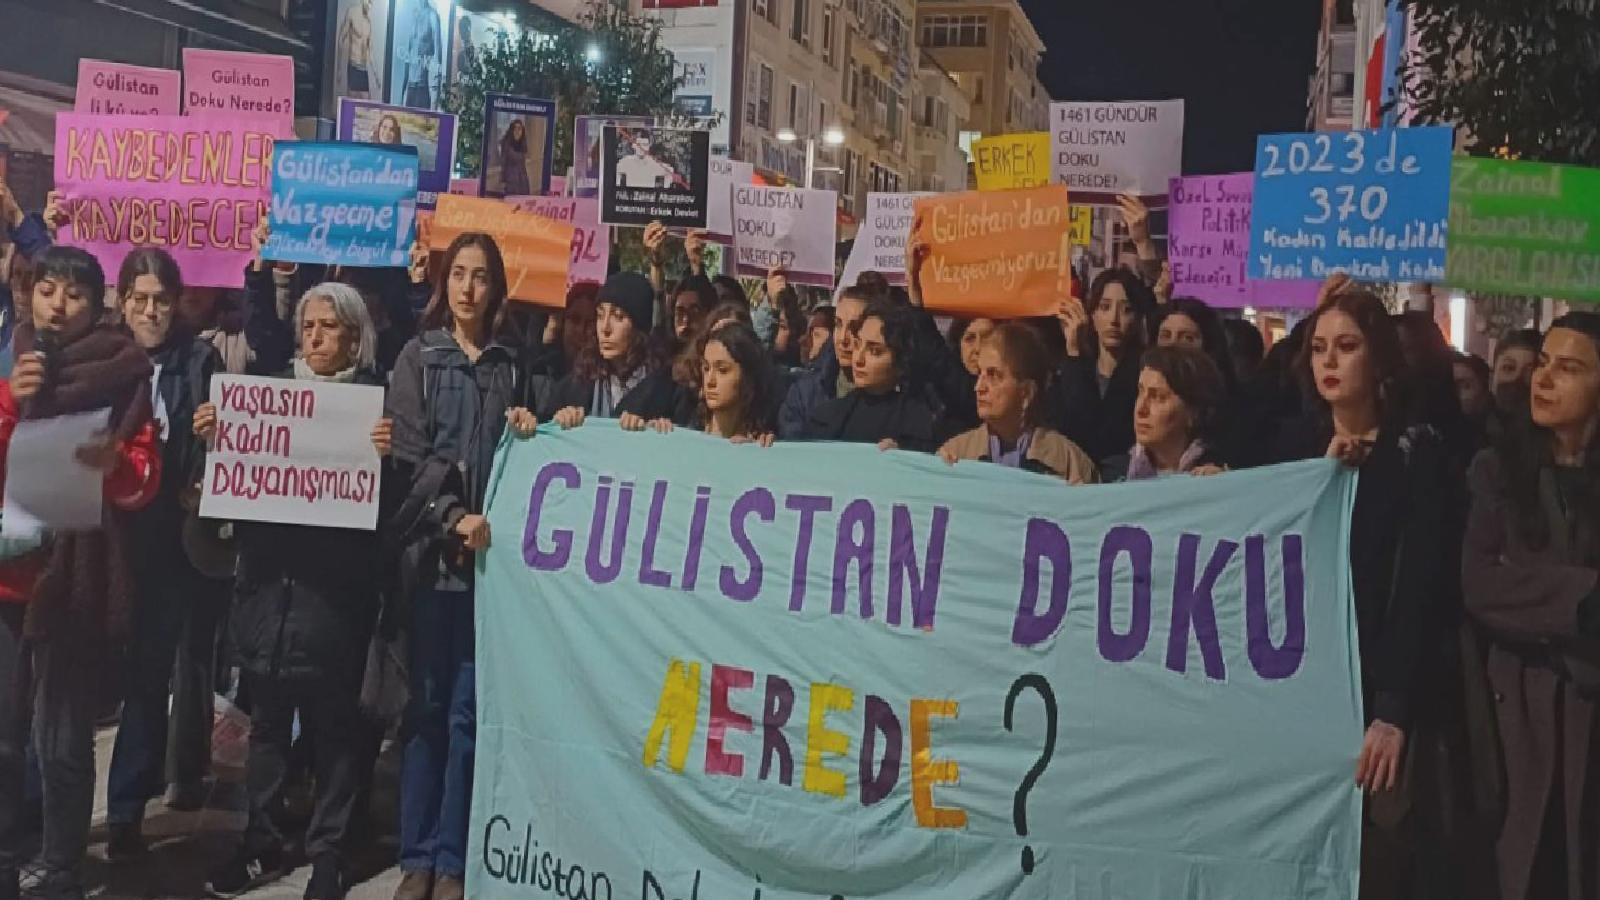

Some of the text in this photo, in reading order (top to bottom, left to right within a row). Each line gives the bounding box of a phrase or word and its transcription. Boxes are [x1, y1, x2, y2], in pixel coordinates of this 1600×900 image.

[93, 71, 159, 96] Gülistan
[211, 69, 270, 88] Gülistan
[189, 91, 292, 114] Doku Nerede?
[1059, 103, 1158, 123] 1461 GÜNDÜR
[1058, 128, 1126, 145] GÜLİSTAN
[978, 142, 1036, 176] ERKEK
[1058, 151, 1100, 167] DOKU
[1059, 174, 1119, 189] NEREDE?
[1304, 185, 1388, 224] 370
[737, 218, 776, 237] DOKU
[216, 419, 291, 458] Kadın
[211, 460, 376, 504] Dayanışması
[521, 460, 1307, 684] GÜLİSTAN DOKU
[642, 657, 968, 829] NEREDE
[483, 814, 612, 900] Gülistan
